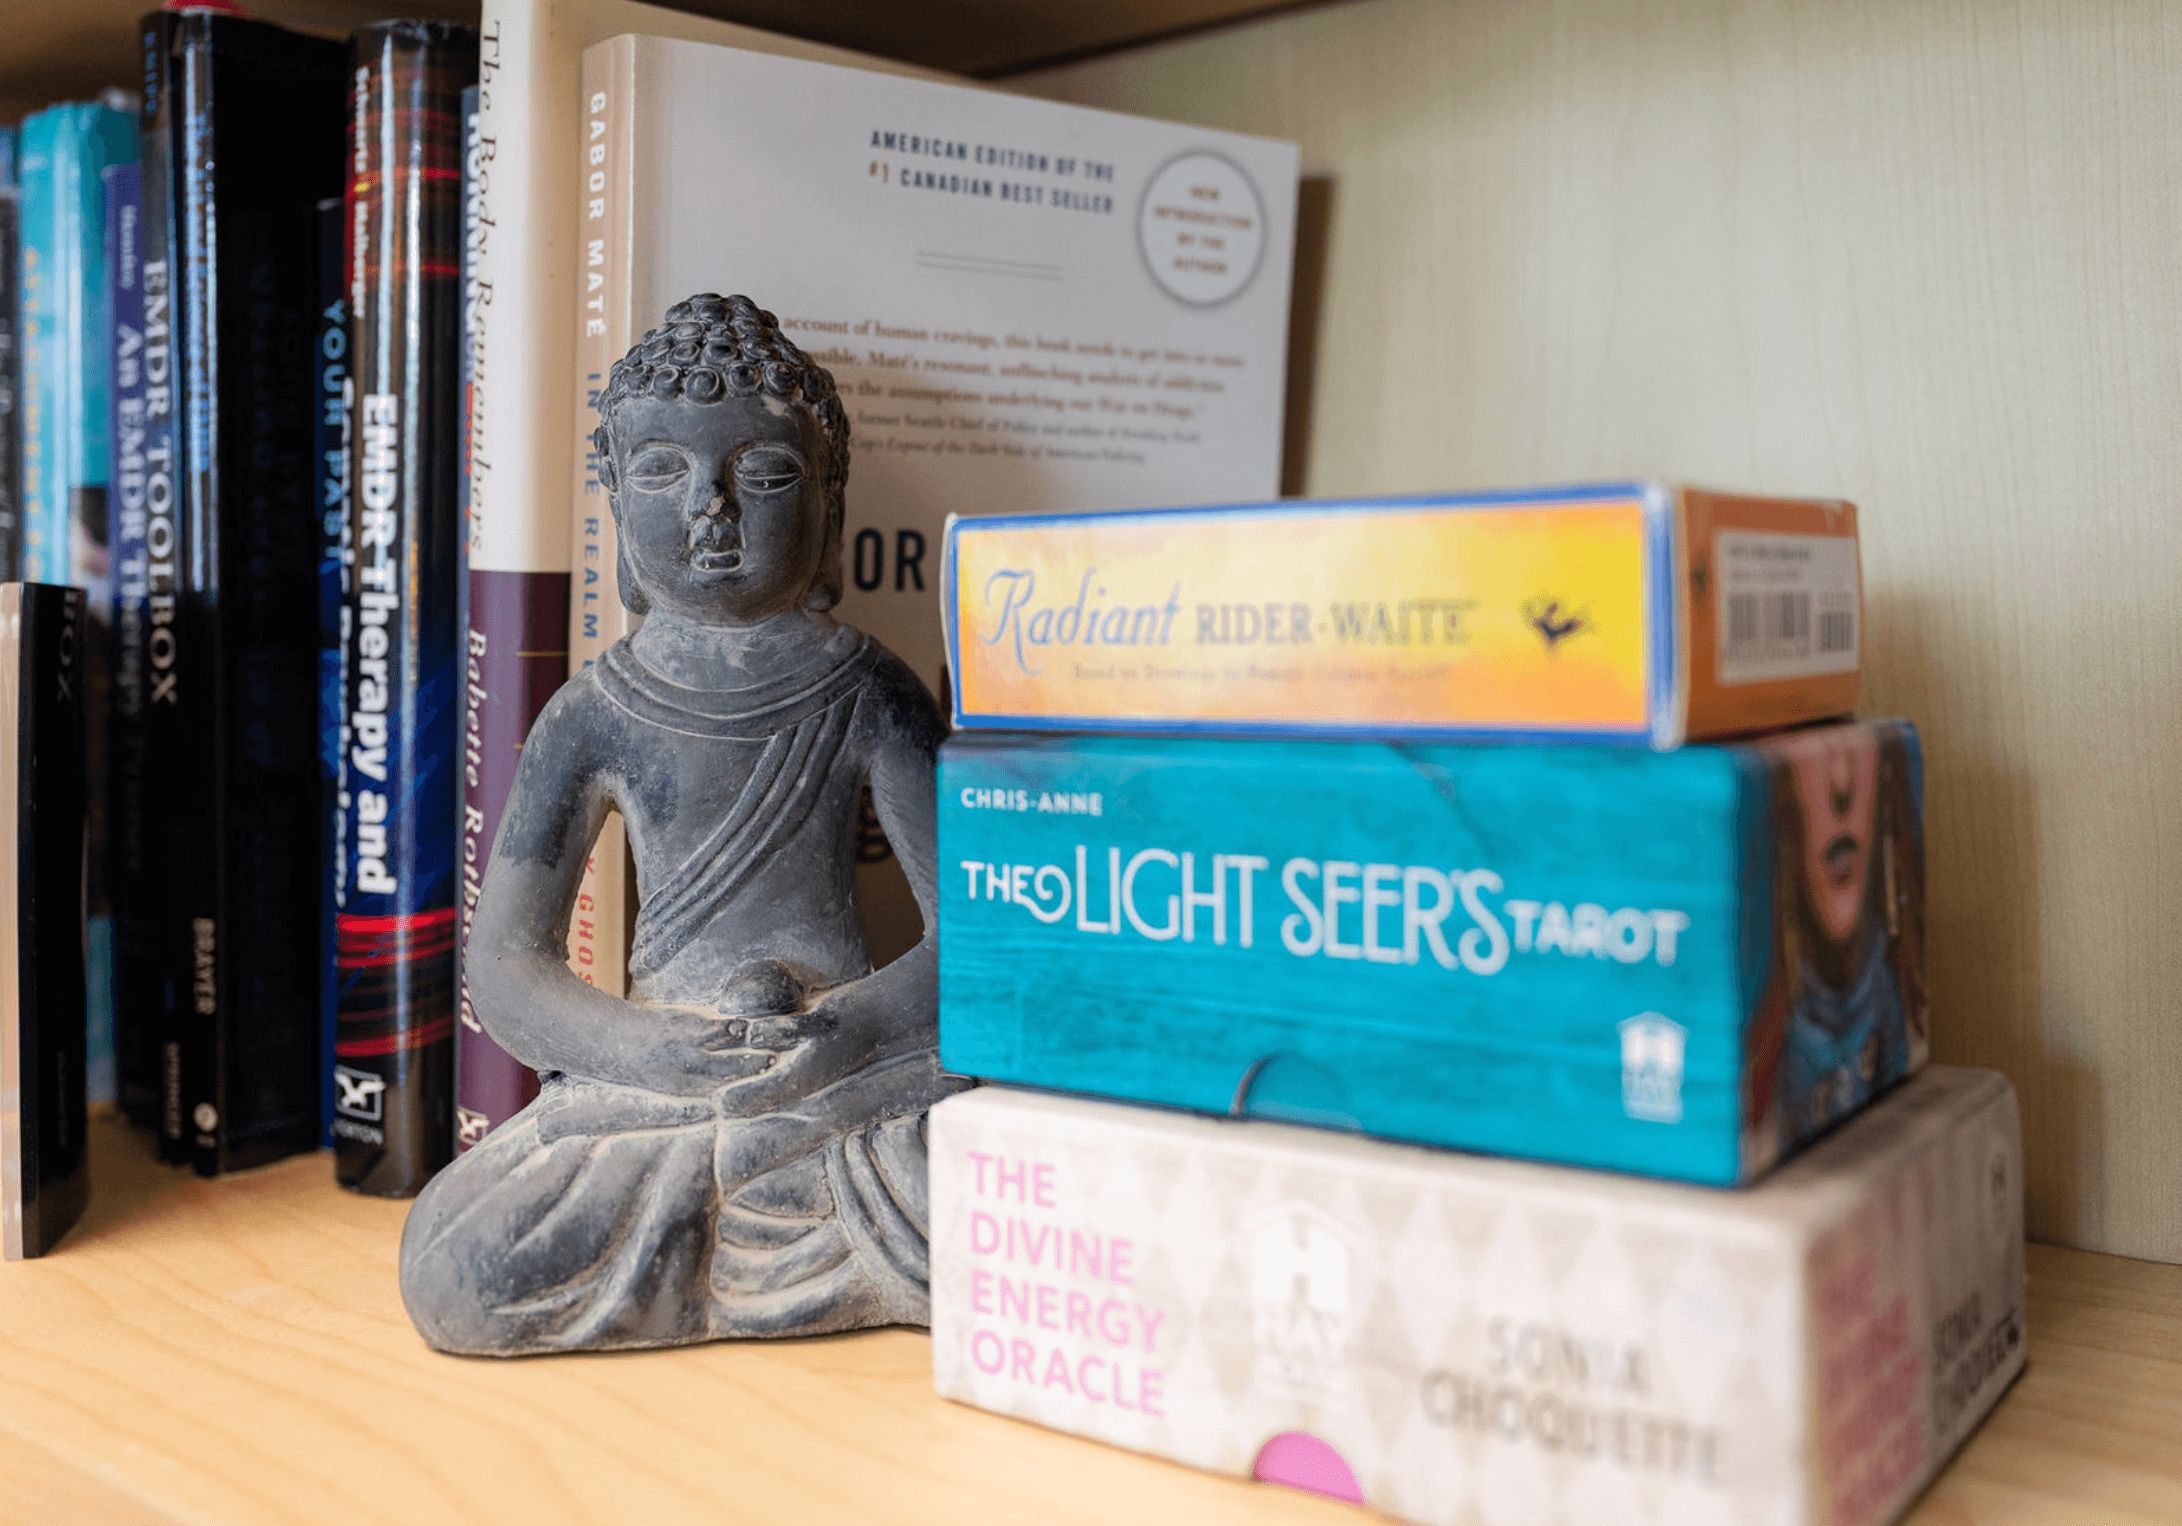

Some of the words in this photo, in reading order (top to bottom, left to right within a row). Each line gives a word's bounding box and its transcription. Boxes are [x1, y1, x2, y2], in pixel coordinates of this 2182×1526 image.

[482, 20, 501, 111] The
[478, 136, 498, 255] Body
[588, 91, 606, 220] GABOR
[869, 160, 889, 184] #1
[900, 168, 994, 197] CANADIAN
[1001, 182, 1043, 205] BEST
[1052, 188, 1114, 214] SELLER
[870, 130, 968, 160] AMERICAN
[975, 145, 1049, 172] EDITION
[1056, 157, 1077, 176] OF
[1083, 160, 1114, 183] THE
[586, 238, 607, 338] MATÉ
[784, 317, 848, 335] account
[854, 319, 872, 336] of
[875, 320, 929, 341] human
[117, 325, 142, 388] An
[144, 260, 169, 419] EMDR
[471, 281, 493, 551] Remembers
[586, 373, 601, 409] IN
[118, 398, 145, 543] EMDR
[361, 394, 398, 548] EMDR
[147, 435, 178, 704] TOOLBOX
[582, 518, 600, 638] REALM
[853, 528, 926, 592] OR
[977, 566, 1182, 677] Radiant
[352, 558, 399, 782] Therapy
[467, 630, 487, 787] Babette
[357, 789, 398, 894] and
[961, 787, 1103, 817] CHRIS-ANNE
[578, 893, 594, 985] GHOS
[961, 859, 1072, 923] THE
[1075, 845, 1269, 949] LIGHT
[1281, 857, 1509, 975] SEER'S
[1504, 899, 1689, 965] TAROT
[967, 1150, 1057, 1210] THE
[968, 1211, 1135, 1286] DIVINE
[970, 1269, 1166, 1354] ENERGY
[1486, 1316, 1653, 1394] SONIA
[970, 1331, 1166, 1418] ORACLE
